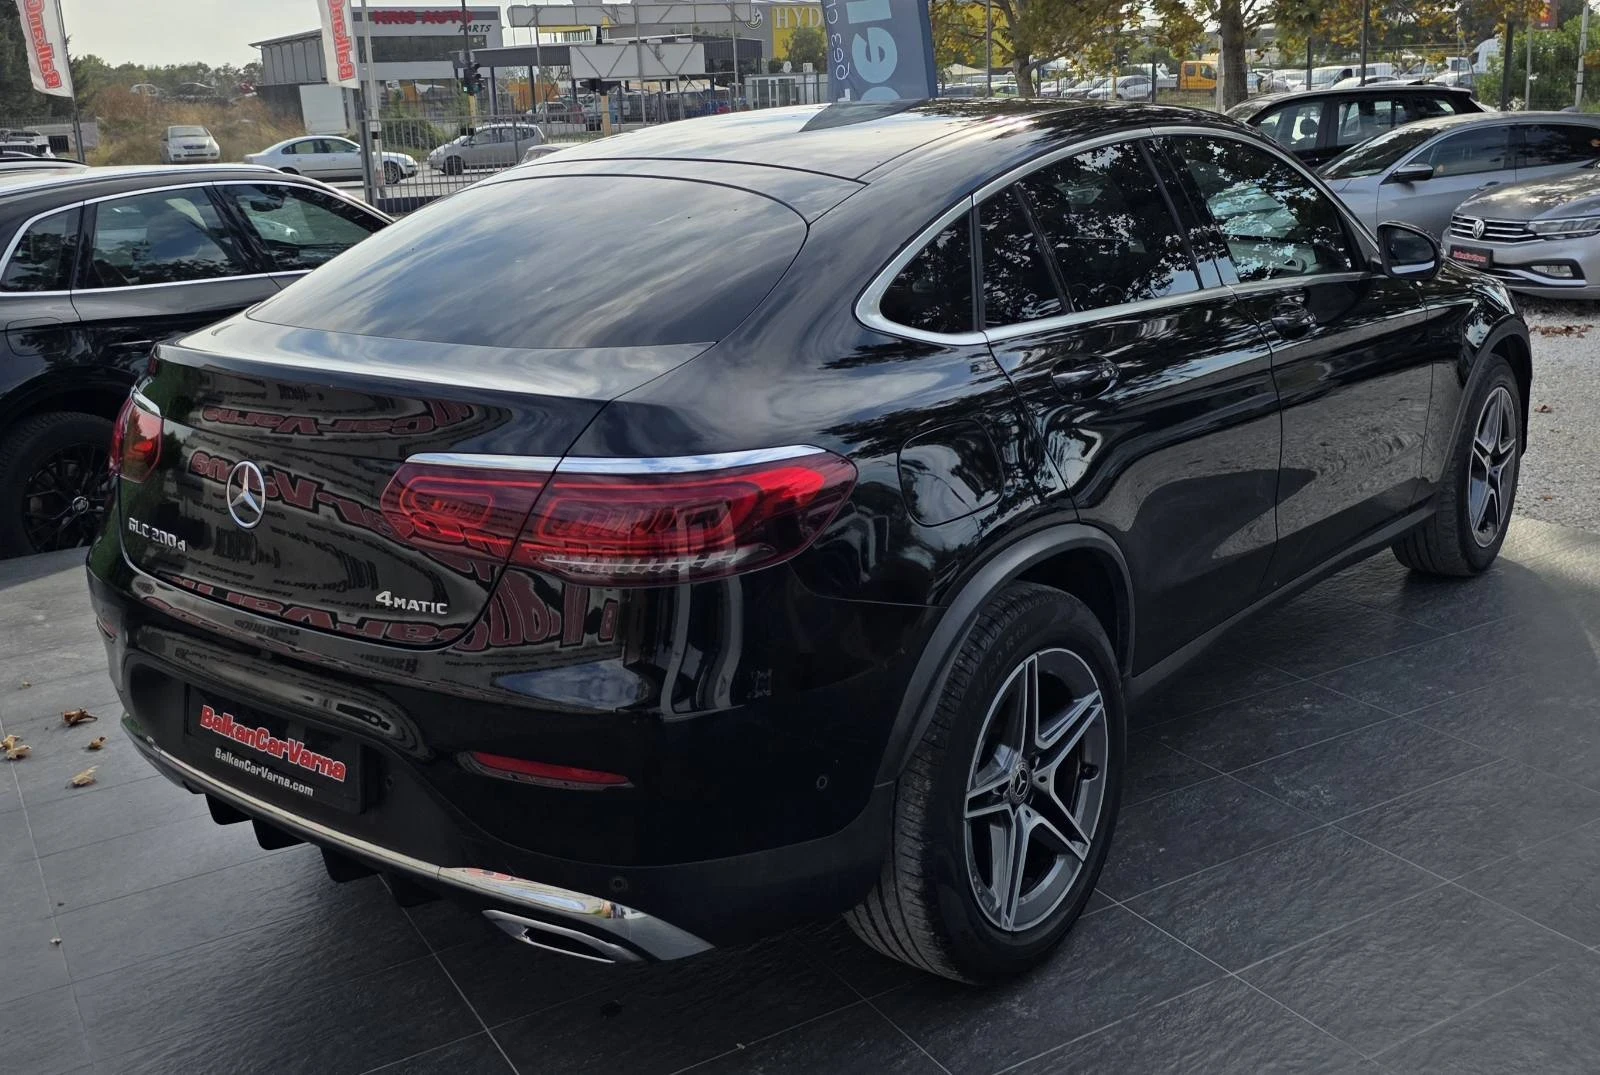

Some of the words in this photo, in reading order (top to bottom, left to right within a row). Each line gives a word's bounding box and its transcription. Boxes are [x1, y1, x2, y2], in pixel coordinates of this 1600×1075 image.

[373, 10, 416, 24] KRIS
[422, 10, 474, 24] AUTO
[458, 24, 492, 33] PARTS
[128, 517, 149, 538] GLC
[375, 590, 449, 615] 4MATIC
[200, 705, 346, 783] BalkanCarVarna
[214, 747, 314, 797] BalkanCarVarna.com
